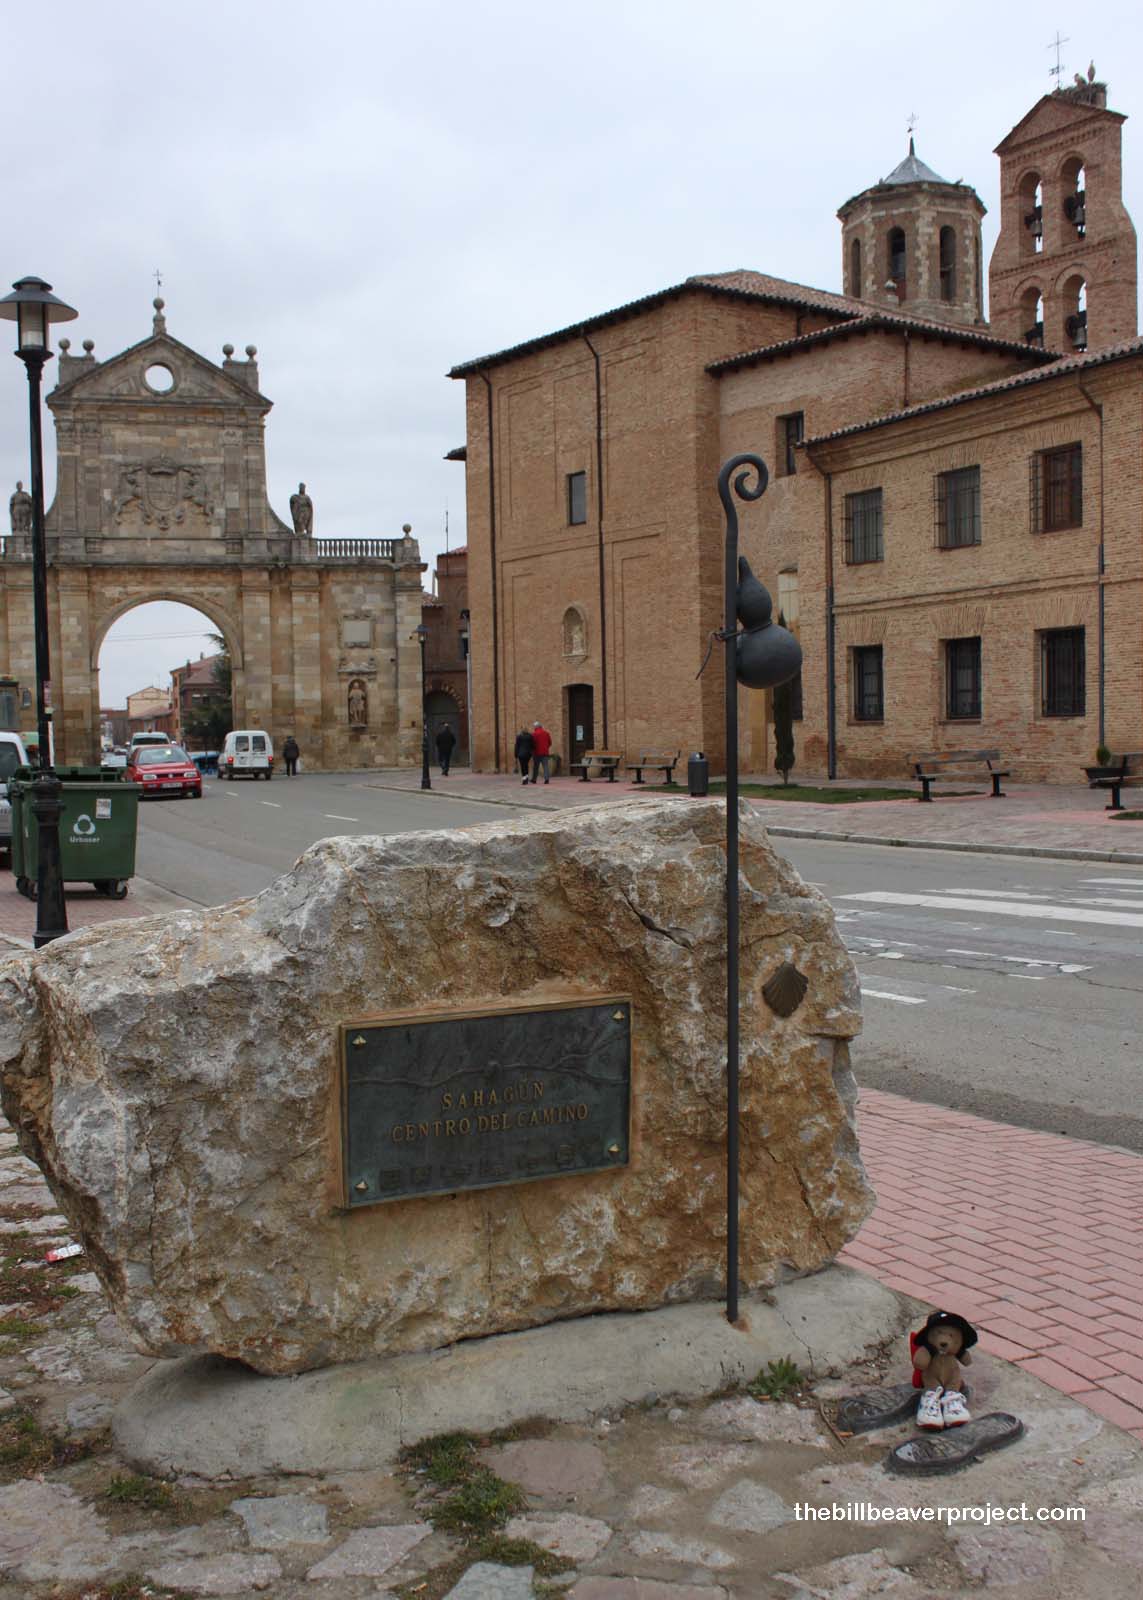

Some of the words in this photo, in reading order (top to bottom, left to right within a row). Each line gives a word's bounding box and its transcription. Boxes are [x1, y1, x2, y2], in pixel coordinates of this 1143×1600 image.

[392, 1117, 471, 1142] CENTRO
[478, 1112, 514, 1134] DEL
[517, 1103, 589, 1128] CAMINO
